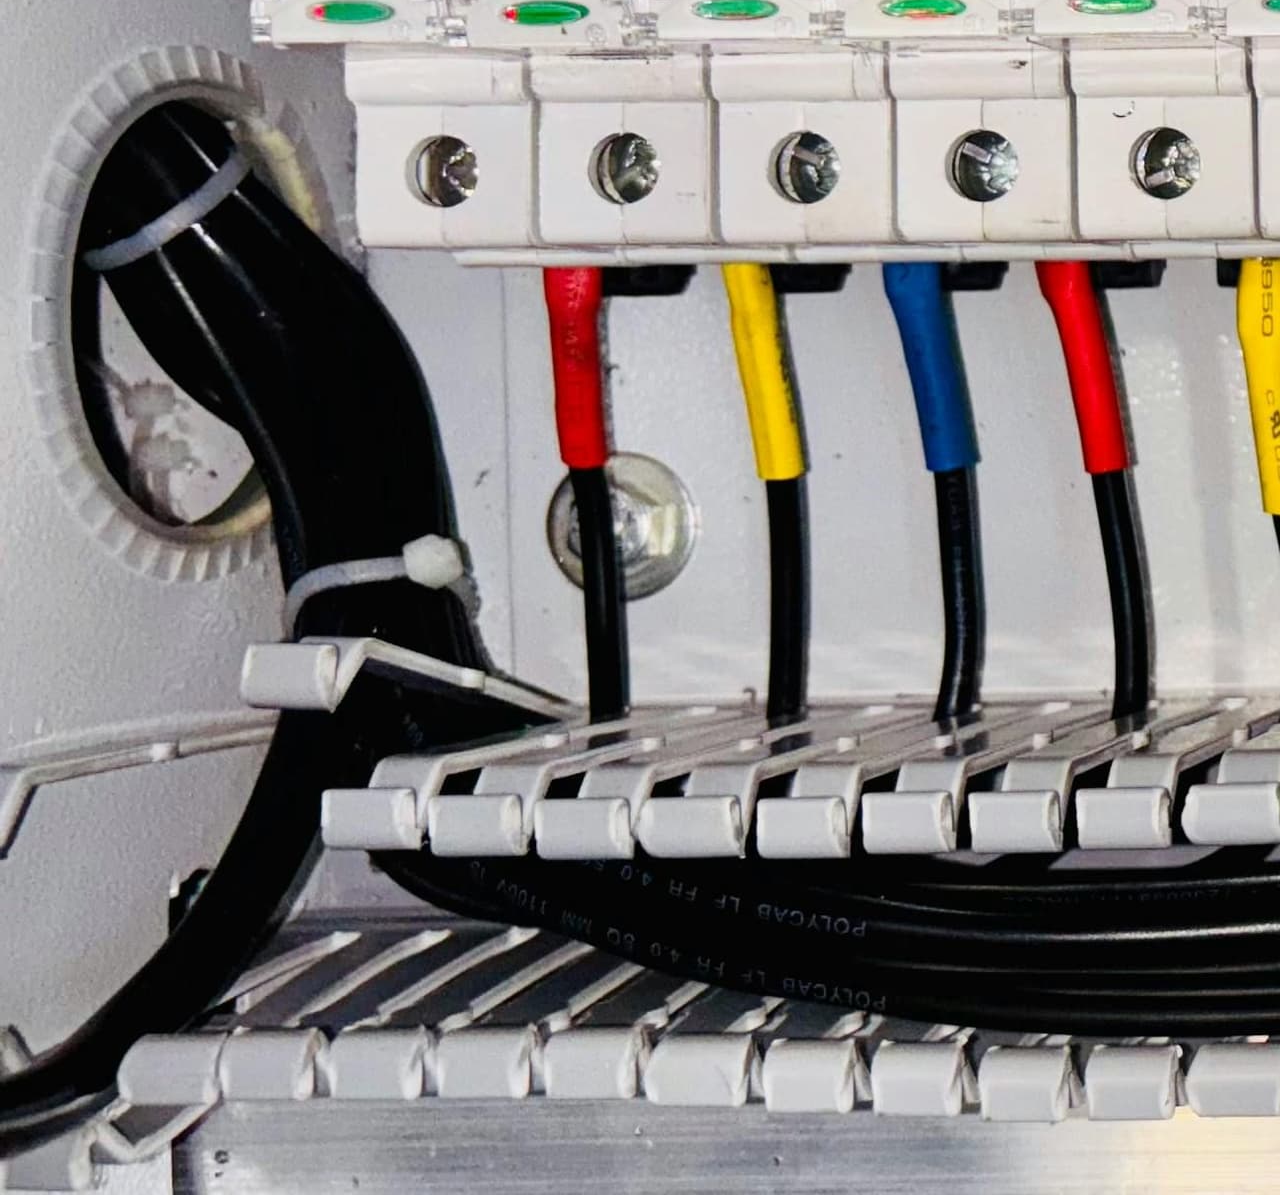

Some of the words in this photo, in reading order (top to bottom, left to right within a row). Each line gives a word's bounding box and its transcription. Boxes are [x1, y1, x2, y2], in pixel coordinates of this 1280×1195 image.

[620, 864, 653, 887] 4.0
[668, 879, 699, 902] FR
[713, 895, 741, 912] LF
[757, 902, 868, 938] POLYCAB
[783, 977, 887, 1011] POLYCAB
